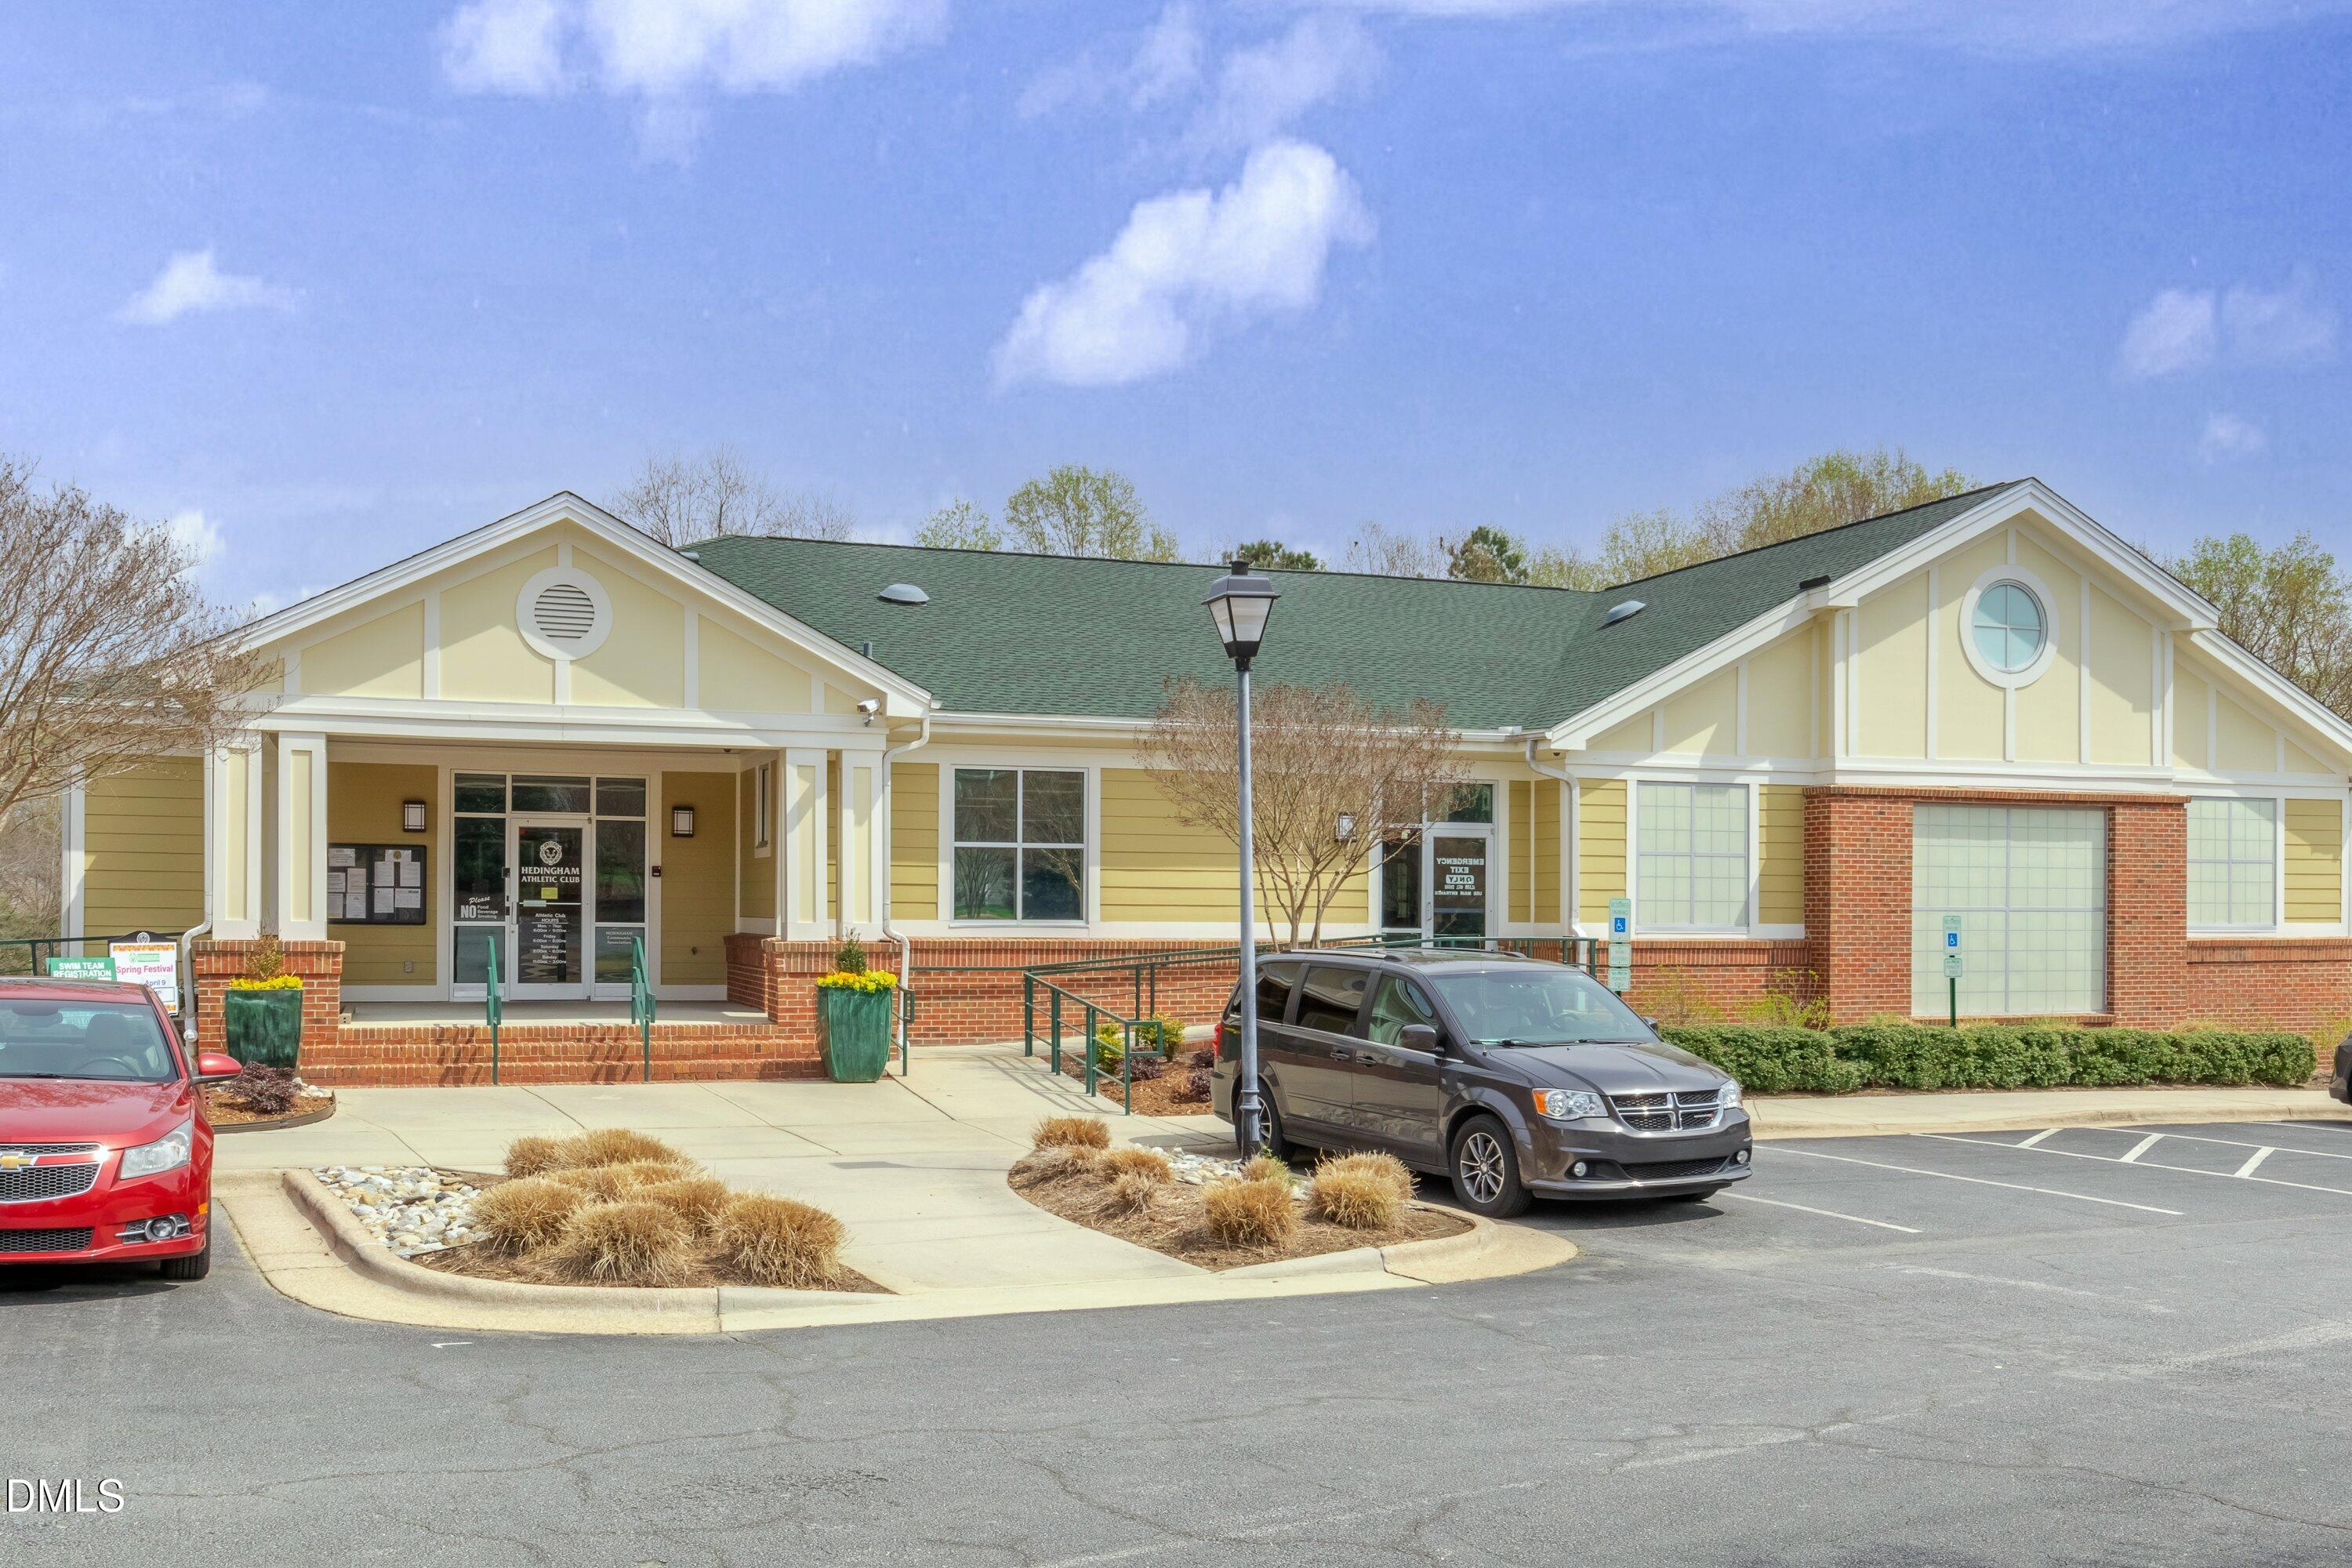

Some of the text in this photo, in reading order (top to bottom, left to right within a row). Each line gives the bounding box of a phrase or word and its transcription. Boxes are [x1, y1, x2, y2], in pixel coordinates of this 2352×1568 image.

[521, 866, 580, 875] HEDINGHAM
[468, 896, 491, 905] Please
[460, 905, 477, 918] NO
[53, 969, 112, 978] REGISTRATION
[116, 964, 173, 975] Spring Festival
